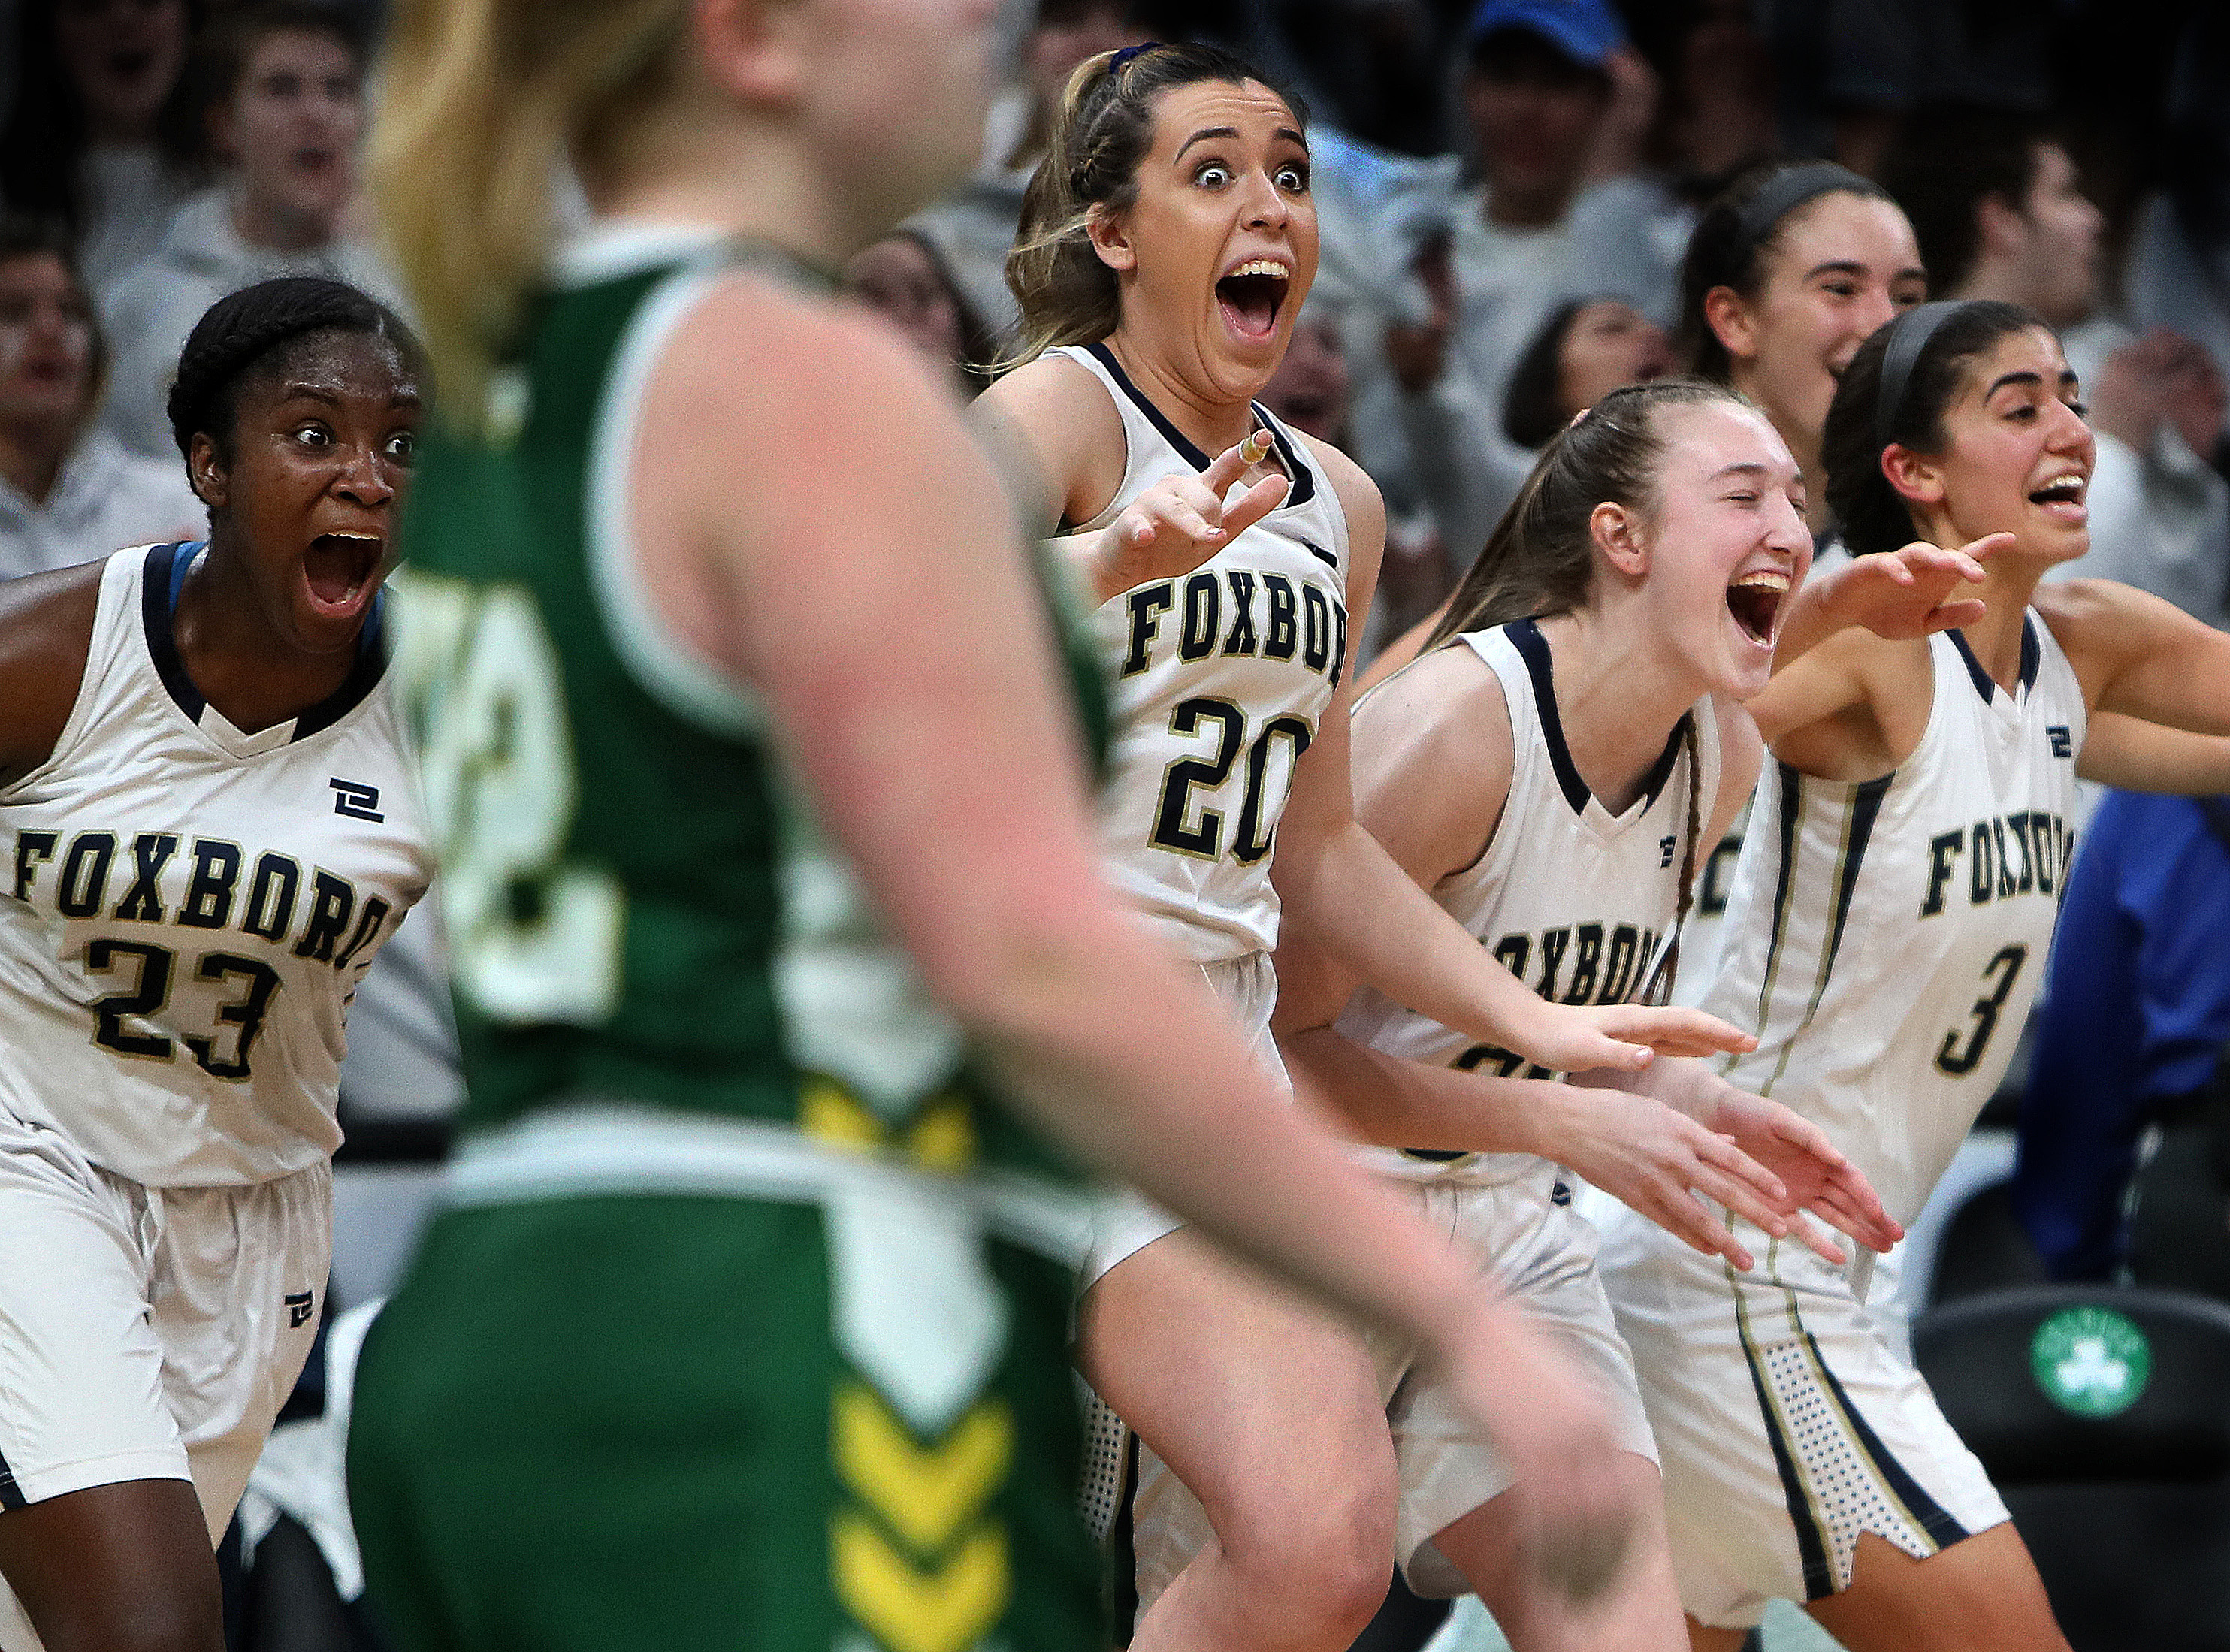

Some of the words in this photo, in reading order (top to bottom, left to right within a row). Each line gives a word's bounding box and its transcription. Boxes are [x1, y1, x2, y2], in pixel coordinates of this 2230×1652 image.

[1147, 696, 1318, 867] 20
[11, 829, 393, 971] FOXBORO
[83, 937, 283, 1083] 23
[1934, 942, 2028, 1077] 3
